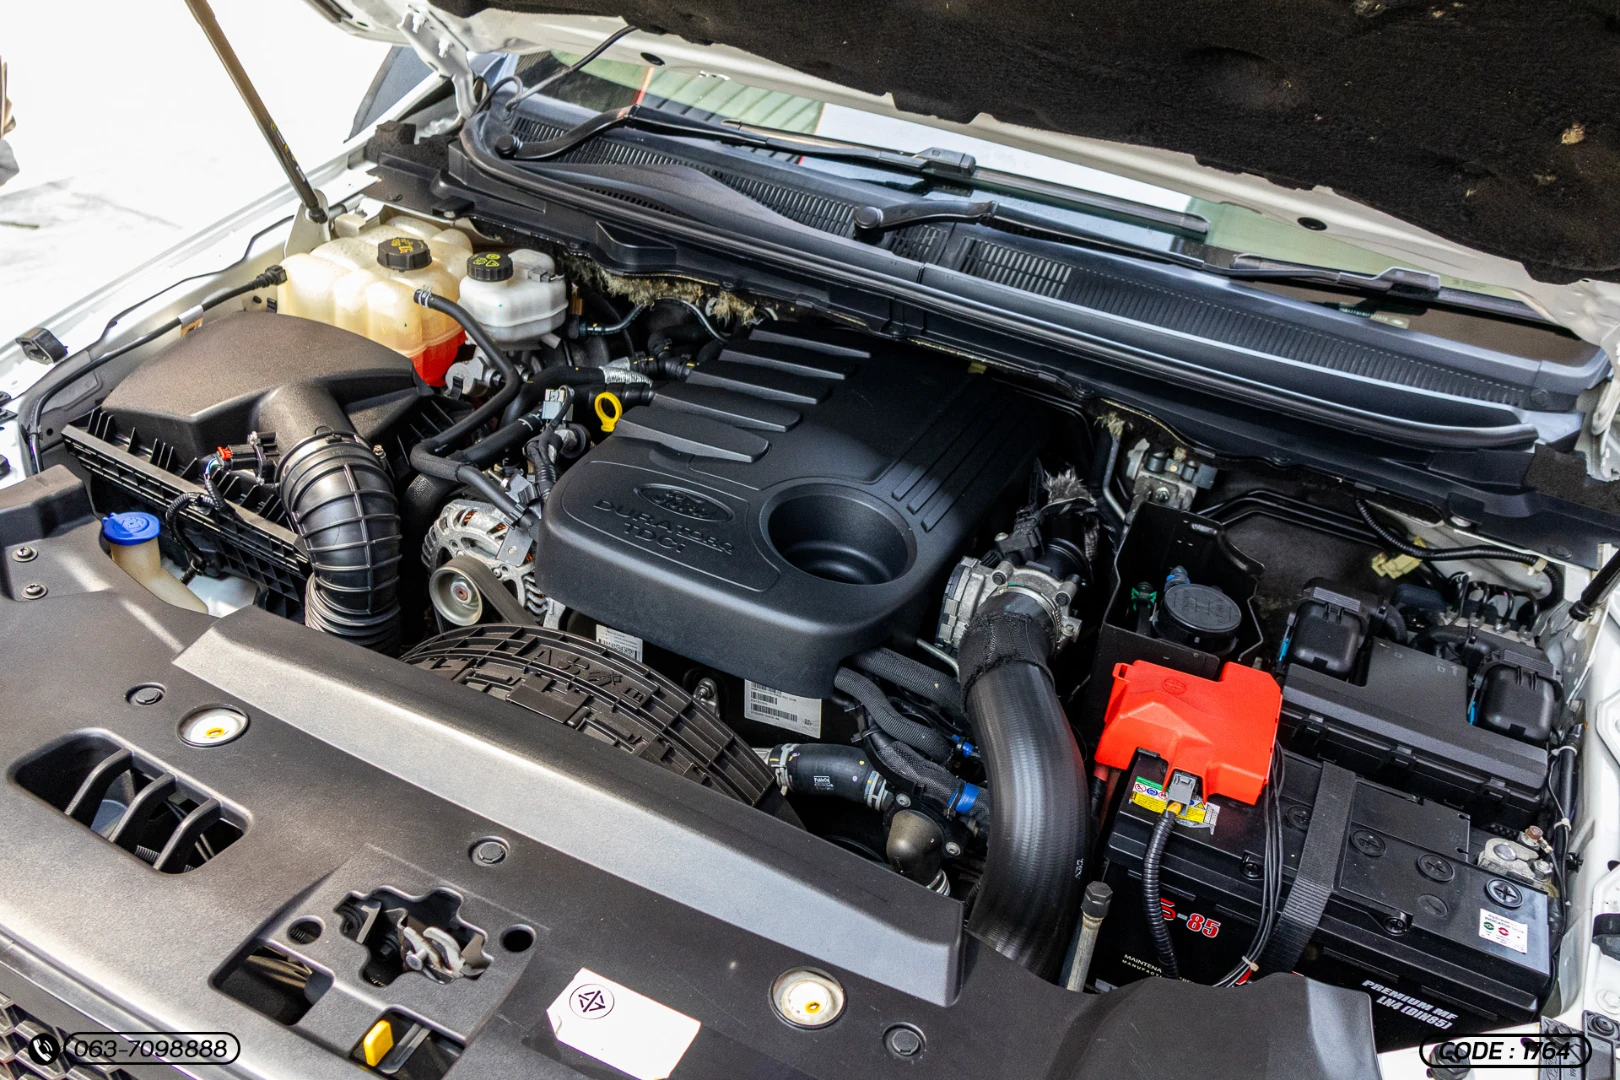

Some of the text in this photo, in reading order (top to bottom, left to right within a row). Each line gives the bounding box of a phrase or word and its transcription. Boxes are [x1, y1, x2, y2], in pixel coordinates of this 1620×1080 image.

[593, 499, 735, 556] DURATORQ
[1362, 980, 1459, 1020] PREMIUM MF
[1376, 995, 1453, 1030] LN4 (DIN85)
